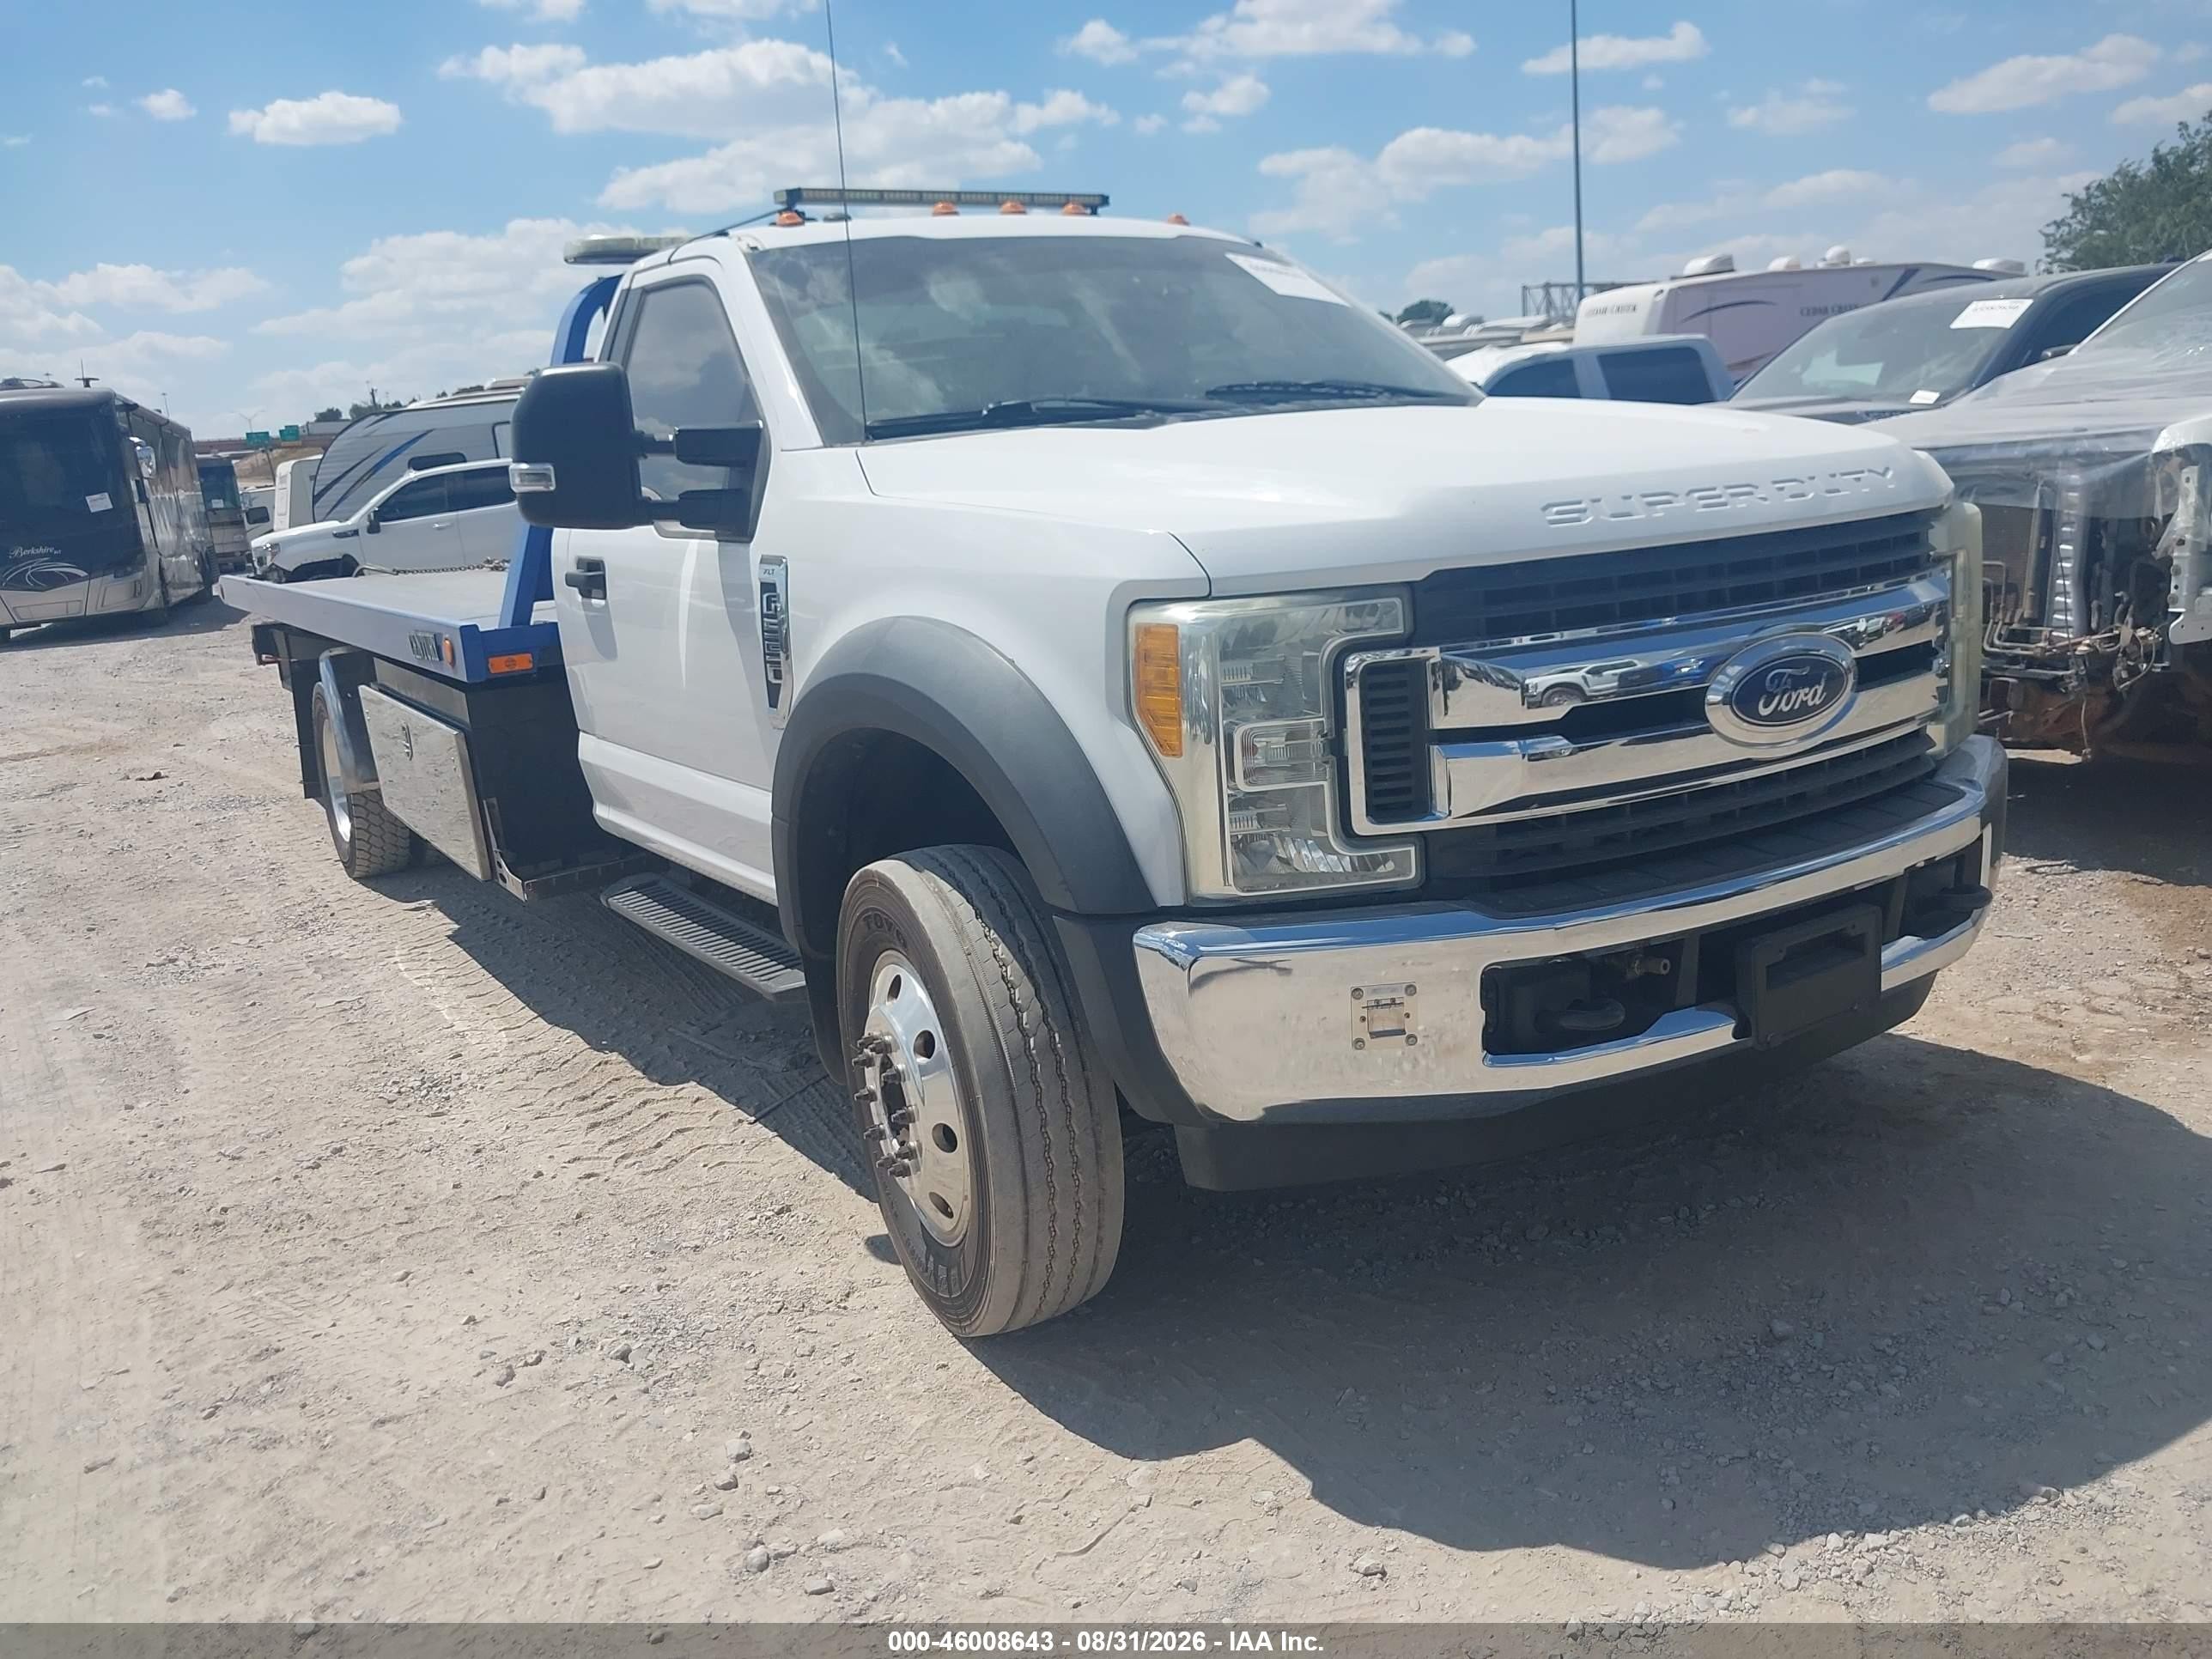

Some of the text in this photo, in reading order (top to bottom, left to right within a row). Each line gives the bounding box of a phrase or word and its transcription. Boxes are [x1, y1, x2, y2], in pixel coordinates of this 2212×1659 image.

[1540, 465, 1897, 528] SUPER DUTY
[8, 544, 55, 559] Berkshire
[1758, 665, 1828, 716] Ford
[859, 910, 908, 950] TOYO
